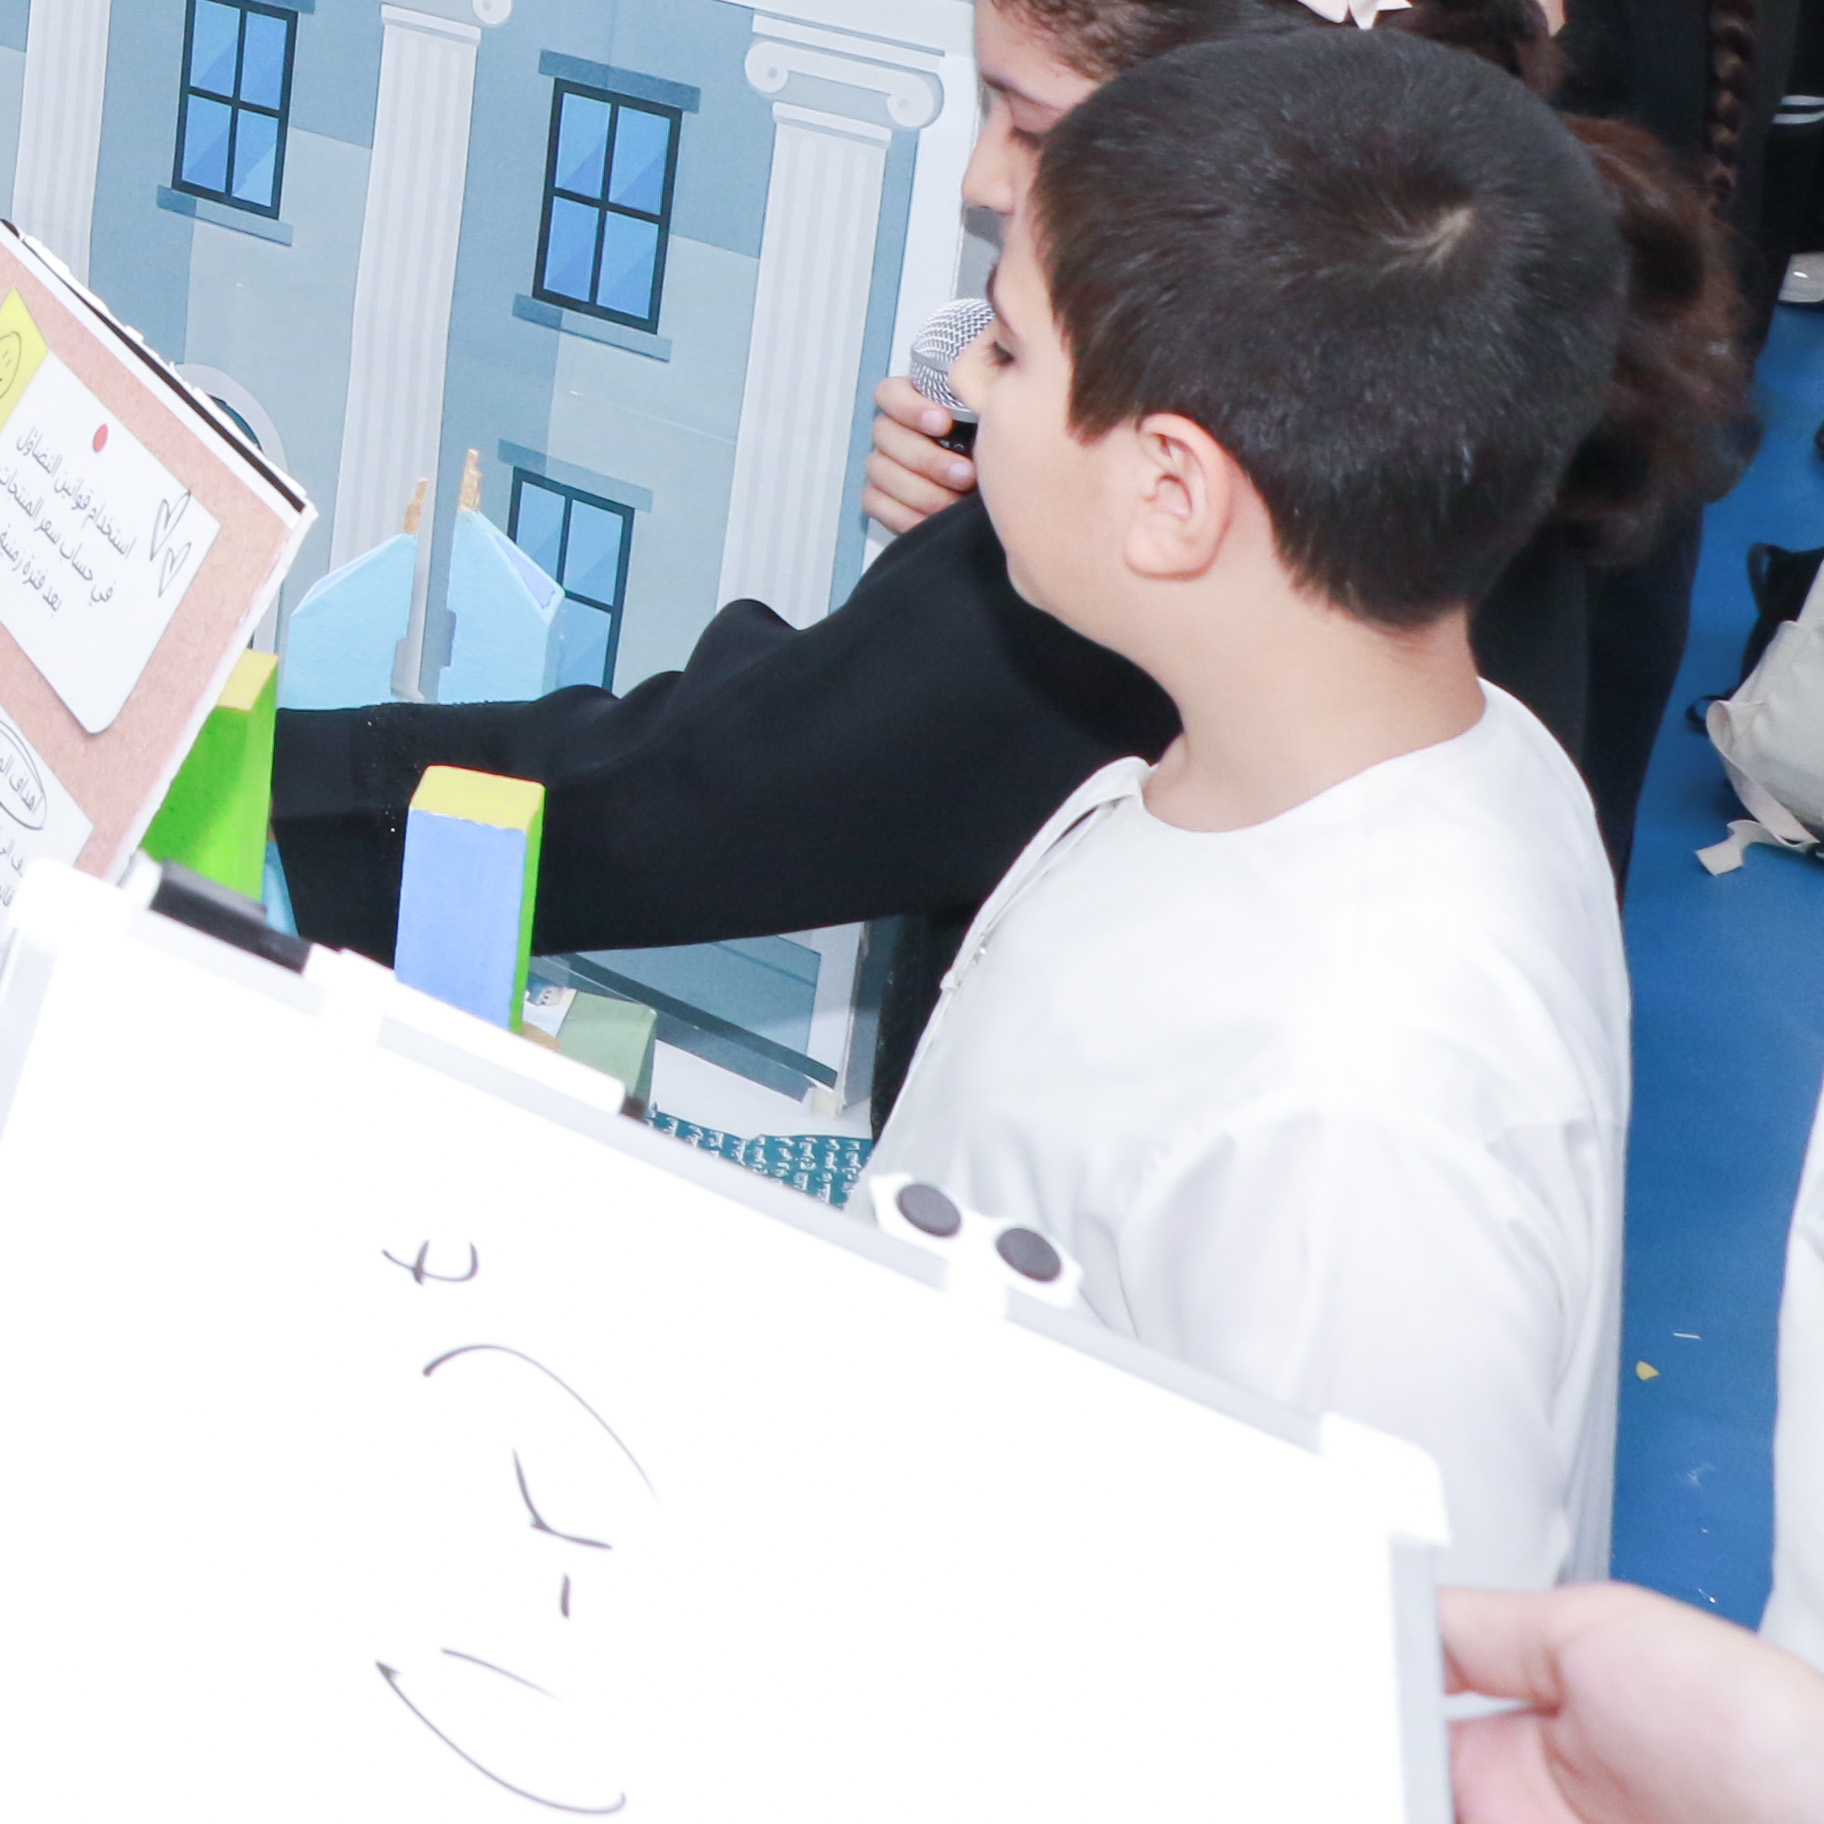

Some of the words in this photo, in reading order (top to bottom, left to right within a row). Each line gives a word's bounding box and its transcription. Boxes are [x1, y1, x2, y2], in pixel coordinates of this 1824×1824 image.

[14, 426, 63, 477] التضاؤل
[52, 477, 94, 511] قوانين
[32, 517, 61, 545] سعر
[80, 503, 137, 558] استخدام
[20, 553, 46, 591] فترة
[57, 541, 94, 582] حساب
[41, 586, 62, 612] بعد
[87, 584, 114, 607] في
